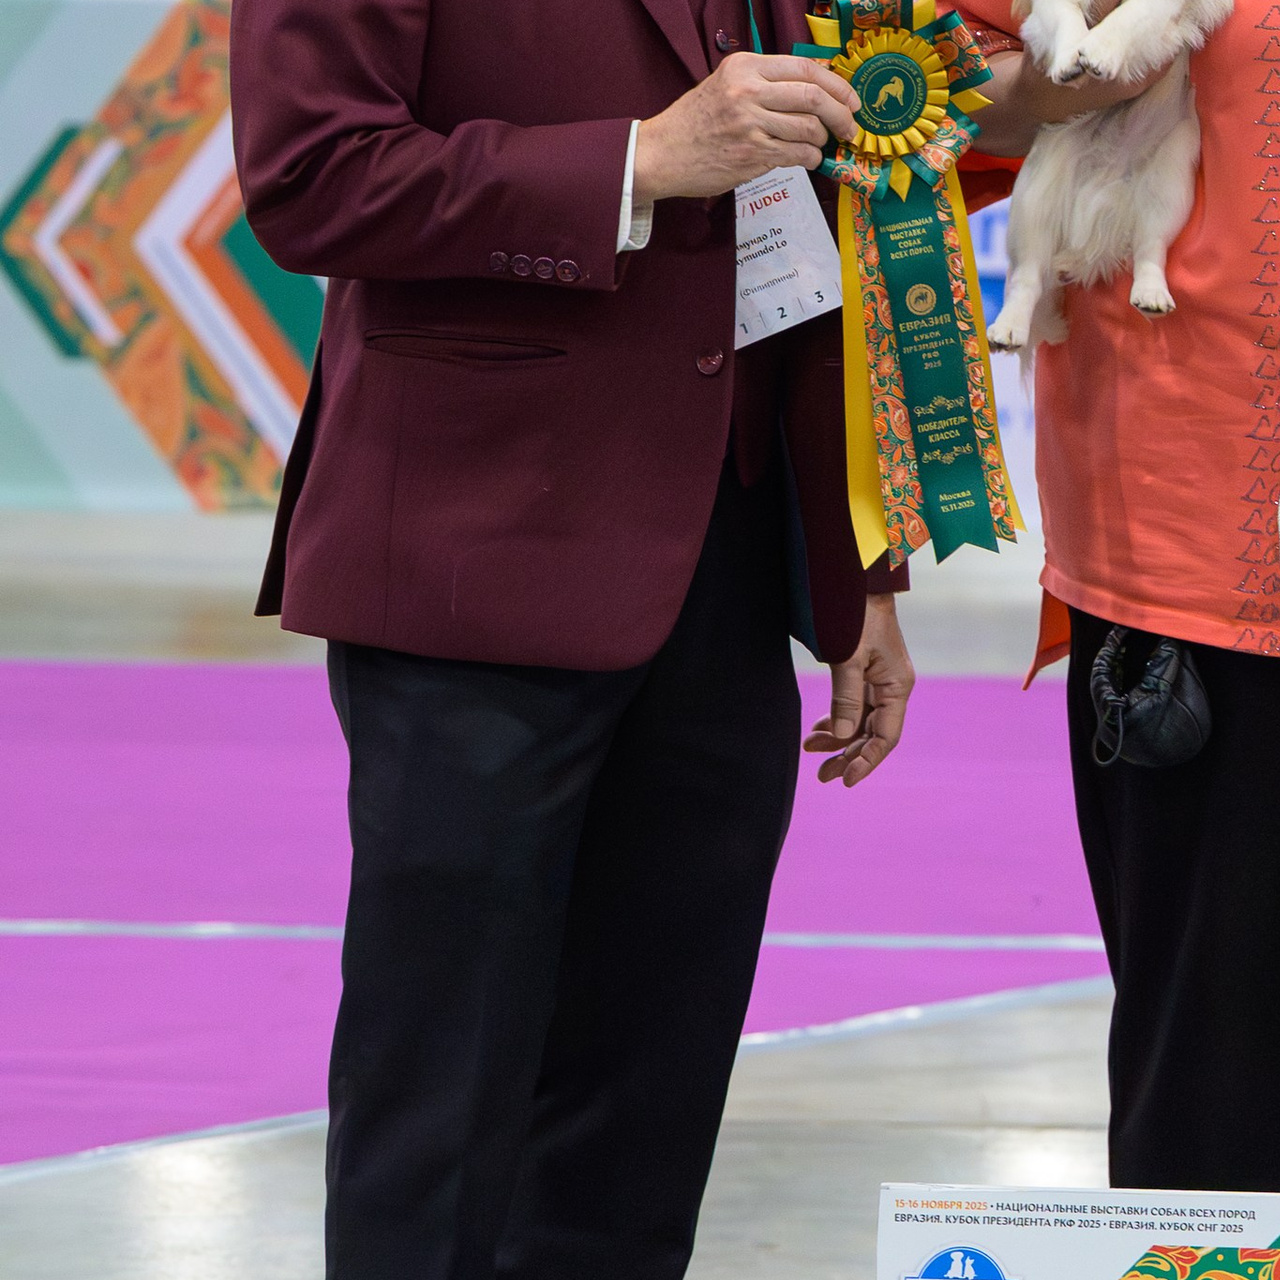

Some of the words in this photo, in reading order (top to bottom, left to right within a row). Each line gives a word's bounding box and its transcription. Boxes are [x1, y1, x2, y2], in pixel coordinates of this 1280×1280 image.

[749, 187, 790, 216] JUDGE
[769, 227, 783, 238] Ло
[890, 228, 927, 240] ВЫСТАВКА
[775, 239, 787, 249] Lo
[898, 238, 922, 248] СОБАК
[890, 250, 909, 260] ВСЕХ
[909, 245, 934, 256] ПОРОД
[739, 268, 799, 300] (Филиппины)
[740, 322, 749, 335] 1
[777, 306, 788, 319] 2
[814, 290, 825, 304] 3
[899, 313, 951, 333] ЕВРАЗИЯ
[917, 415, 968, 434] ПОБЕДИТЕЛЬ
[928, 429, 961, 443] КЛАССА
[939, 490, 972, 502] Москва
[940, 500, 976, 513] 15.11.2025
[895, 1199, 919, 1208] 15-16
[921, 1200, 963, 1210] НОЯБРЯ
[965, 1201, 988, 1211] 2025
[996, 1202, 1088, 1214] НАЦИОНАЛЬНЫЕ
[1090, 1205, 1148, 1216] ВЫСТАВКИ
[1150, 1207, 1187, 1217] СОБАК
[1189, 1208, 1216, 1218] ВСЕХ
[1218, 1210, 1256, 1221] ПОРОД
[894, 1213, 943, 1224] ЕВРАЗИЯ.
[945, 1215, 980, 1225] КУБОК
[982, 1216, 1052, 1228] ПРЕЗИДЕНТА
[1054, 1218, 1075, 1228] РКФ
[1077, 1219, 1101, 1229] 2025
[1109, 1221, 1157, 1231] ЕВРАЗИЯ.
[1159, 1222, 1195, 1232] КУБОК
[1197, 1223, 1218, 1232] СНГ
[1220, 1224, 1244, 1233] 2025
